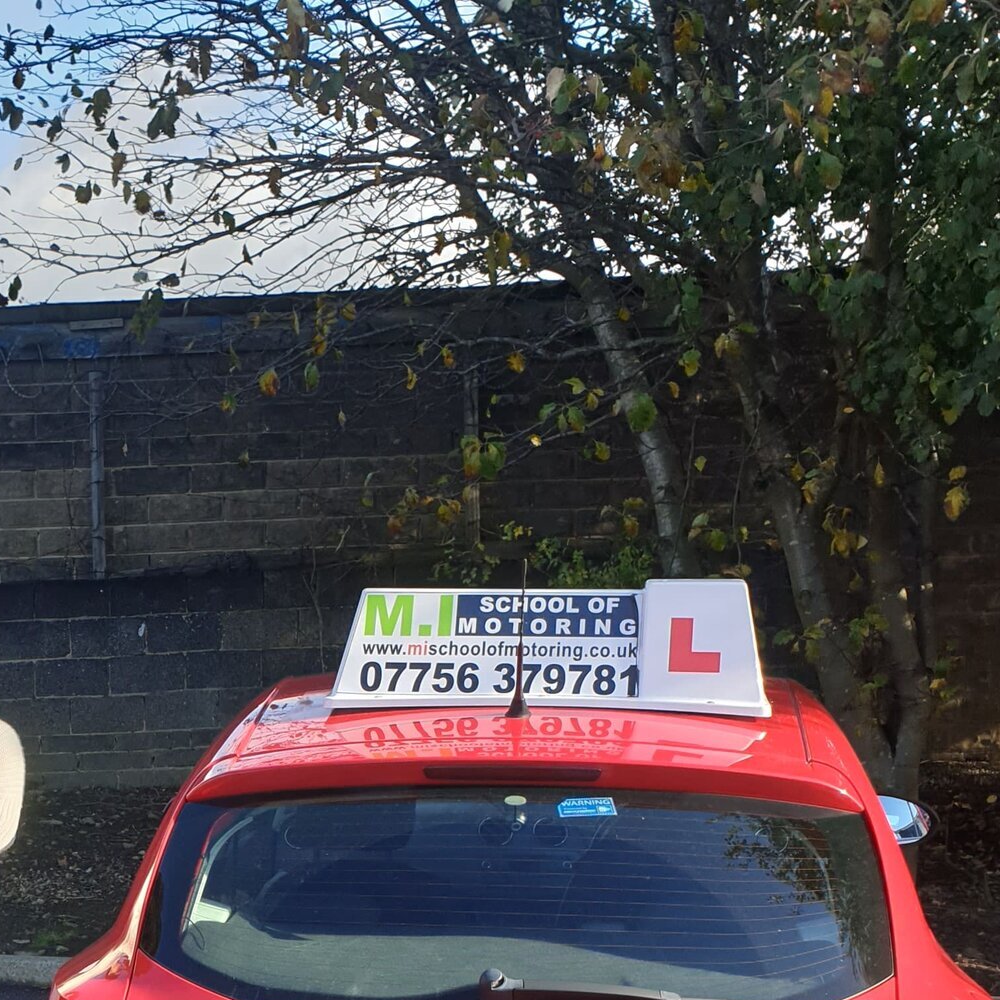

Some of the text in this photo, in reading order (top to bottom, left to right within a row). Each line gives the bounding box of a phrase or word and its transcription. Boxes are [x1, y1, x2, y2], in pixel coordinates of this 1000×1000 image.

[363, 595, 454, 636] M.I
[479, 596, 620, 614] SCHOOL OF
[458, 617, 636, 635] MOTORING
[362, 641, 637, 661] www.mischoolofmotoring.co.uk
[668, 617, 721, 673] L
[360, 661, 638, 697] 07756 379781
